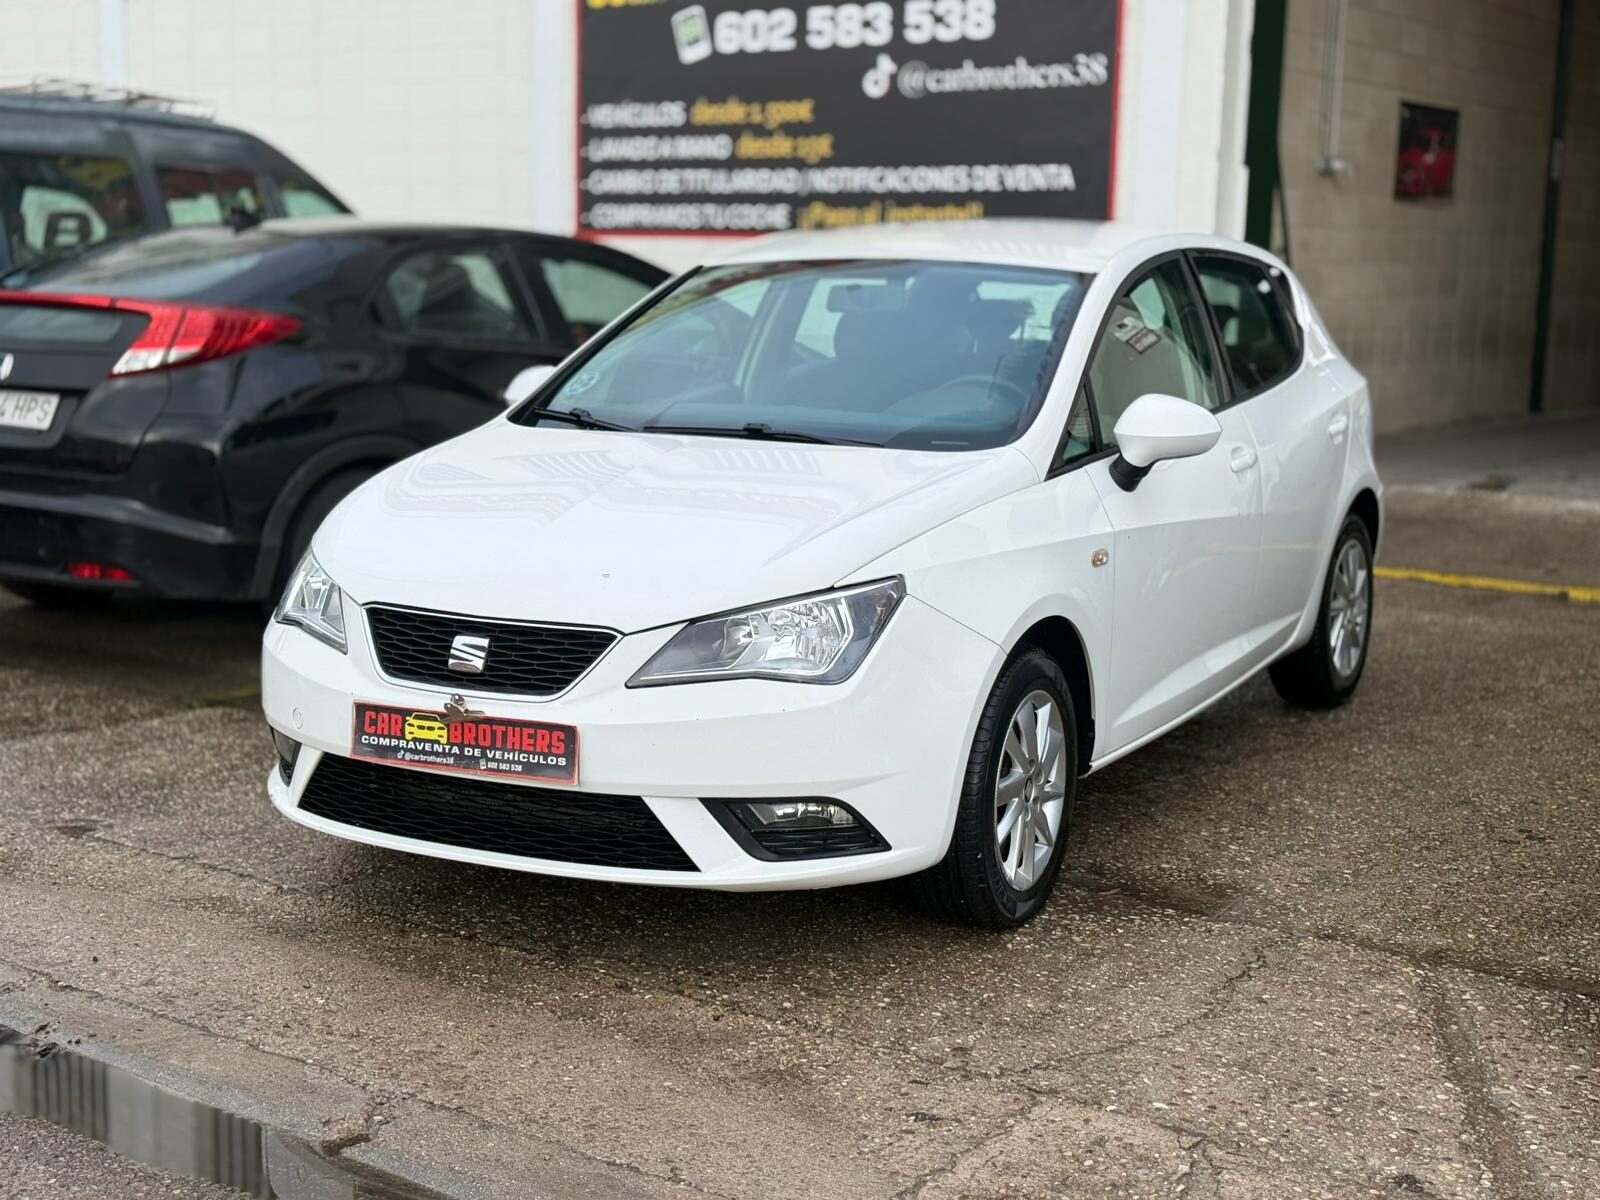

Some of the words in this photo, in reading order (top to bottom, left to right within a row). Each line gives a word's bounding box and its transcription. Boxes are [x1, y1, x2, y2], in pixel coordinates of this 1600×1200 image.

[714, 8, 798, 54] 602
[805, 3, 894, 49] 583
[903, 0, 996, 43] 538
[1002, 163, 1076, 192] VENTA
[11, 393, 51, 423] HPS
[364, 711, 403, 736] CAR
[449, 721, 565, 754] BROTHERS
[361, 735, 460, 754] COMPRAVENTA
[464, 747, 482, 757] DE
[486, 749, 567, 766] VEHÍCULOS
